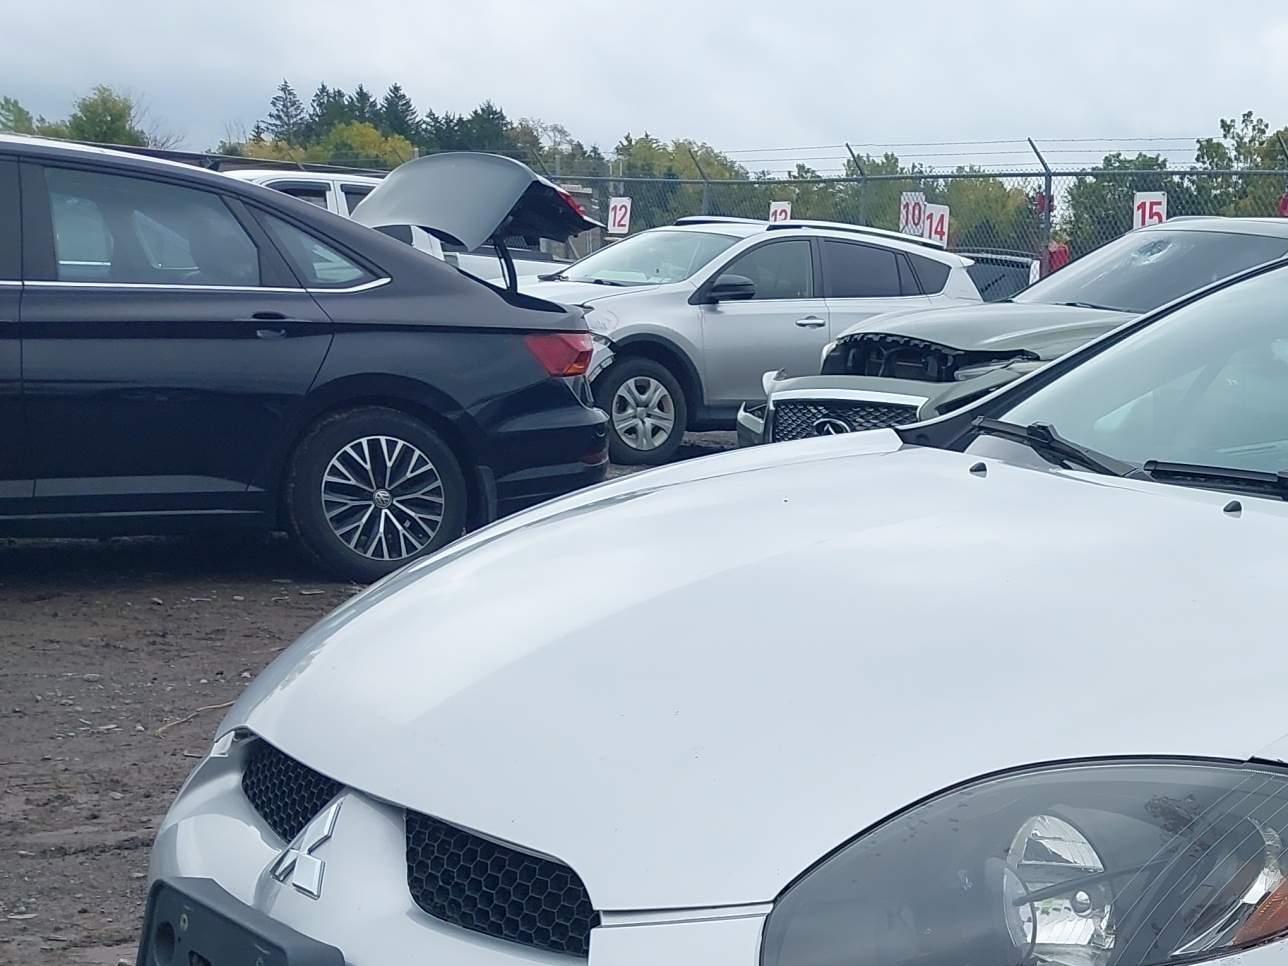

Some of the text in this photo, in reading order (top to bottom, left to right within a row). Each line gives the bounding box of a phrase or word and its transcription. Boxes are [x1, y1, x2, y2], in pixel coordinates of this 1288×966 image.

[611, 204, 628, 227] 12
[903, 202, 921, 226] 10
[1136, 200, 1163, 226] 15
[926, 212, 946, 241] 14
